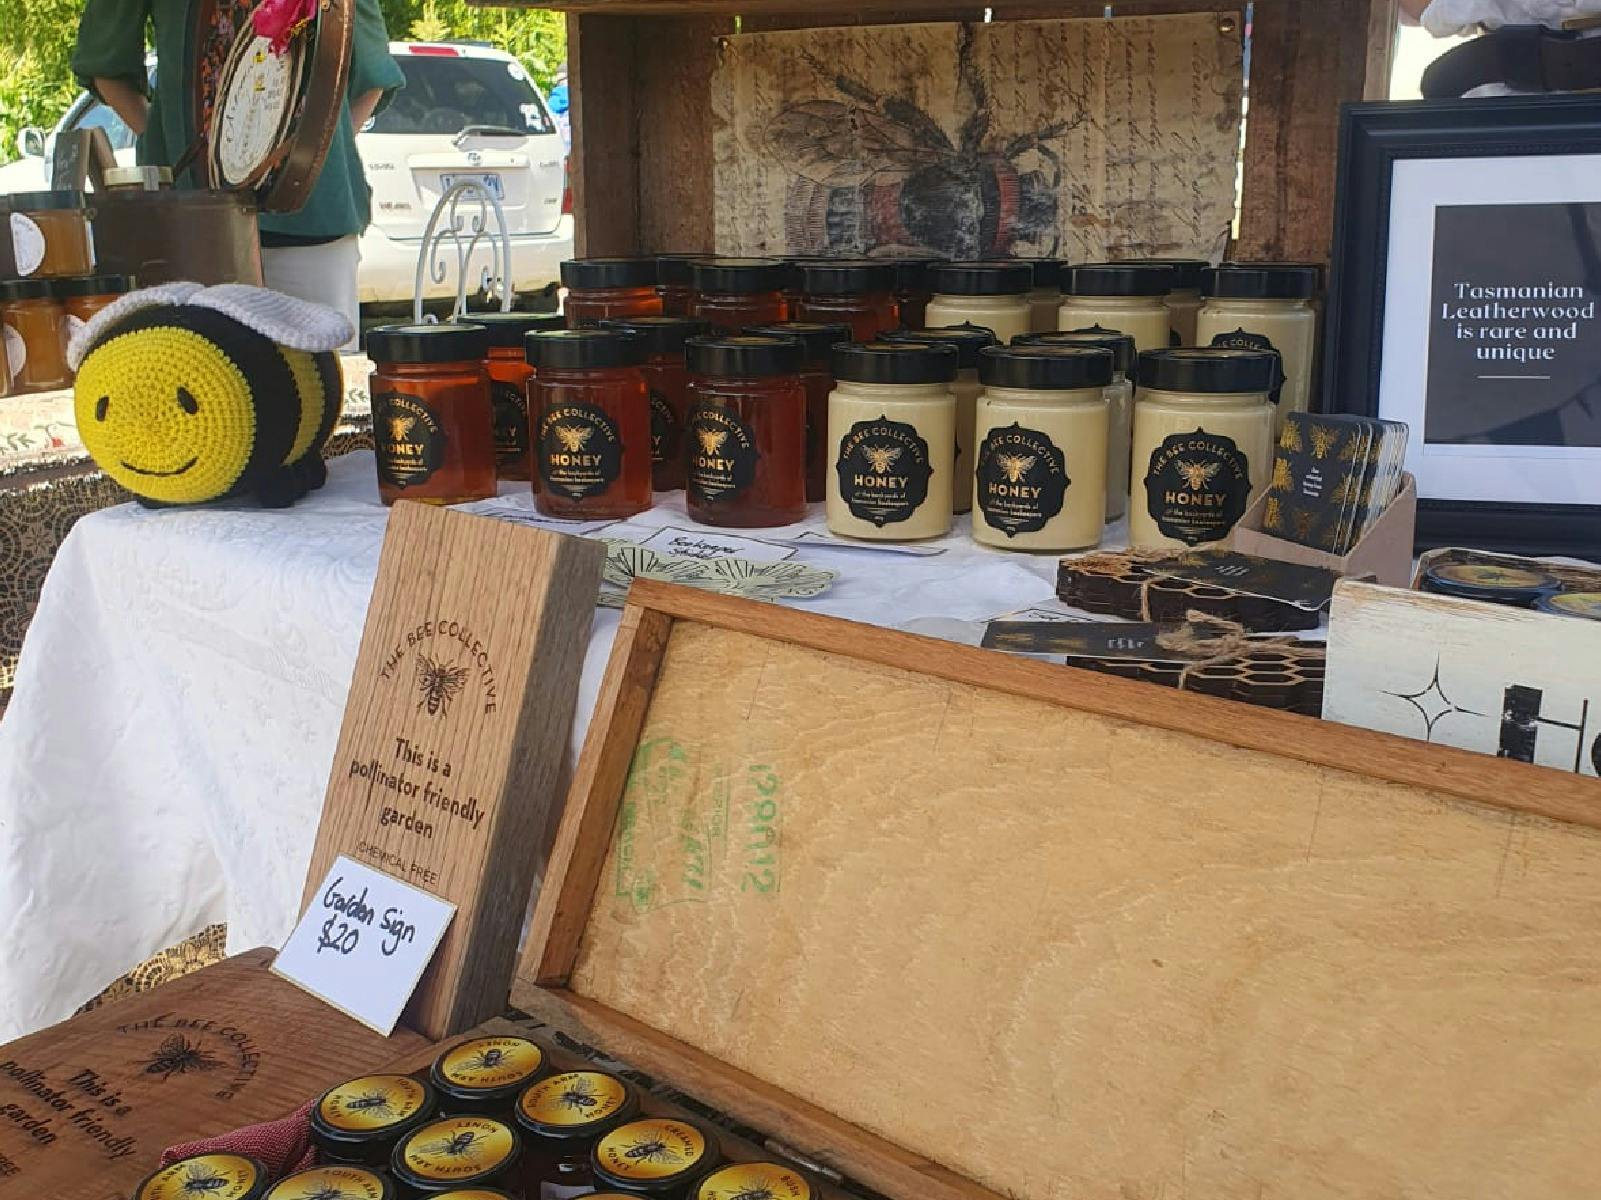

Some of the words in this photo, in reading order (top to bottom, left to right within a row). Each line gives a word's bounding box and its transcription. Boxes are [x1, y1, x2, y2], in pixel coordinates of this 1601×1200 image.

[1453, 281, 1583, 299] Tasmanian
[1442, 302, 1595, 319] Leatherwood
[1457, 322, 1474, 339] is
[1479, 325, 1527, 339] rare
[1533, 322, 1577, 339] and
[1477, 343, 1555, 363] unique
[550, 453, 602, 467] HONEY
[871, 426, 923, 464] COLLECTIVE
[1006, 434, 1060, 475] COLLECTIVE
[853, 473, 909, 489] HONEY
[987, 481, 1042, 498] HONEY
[1165, 490, 1227, 506] HONEY
[378, 643, 405, 681] THE
[406, 620, 433, 649] BEE
[438, 619, 498, 715] COLLECTIVE
[395, 737, 424, 768] This
[426, 749, 440, 774] is
[442, 762, 452, 778] a
[348, 758, 421, 799] pollinator
[423, 780, 486, 830] friendly
[380, 805, 433, 839] garden
[356, 840, 407, 872] CHEMICAL
[410, 861, 440, 885] FREE
[316, 913, 360, 955] $20
[323, 876, 375, 926] Garden
[379, 908, 416, 957] Sign
[68, 1068, 107, 1097] This
[98, 1091, 121, 1107] is
[0, 1060, 76, 1112] pollinator
[66, 1107, 137, 1160] friendly
